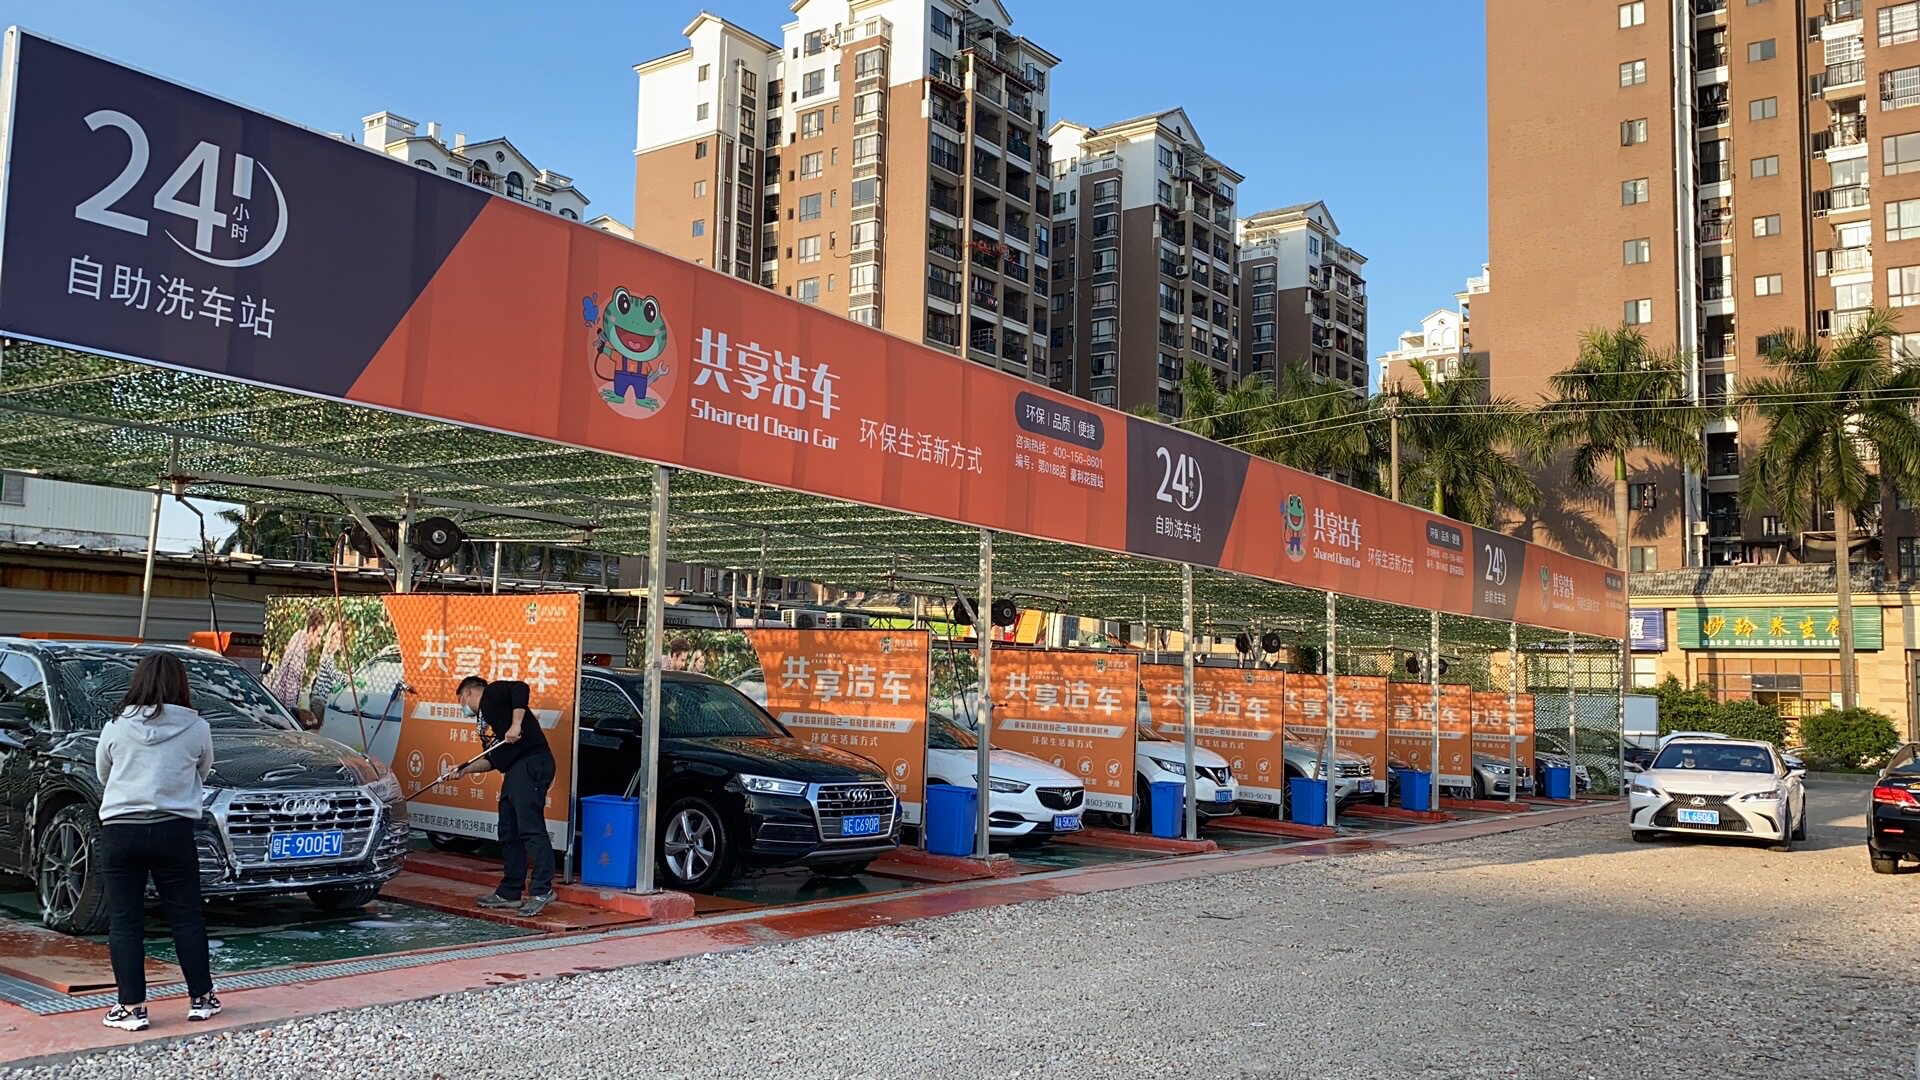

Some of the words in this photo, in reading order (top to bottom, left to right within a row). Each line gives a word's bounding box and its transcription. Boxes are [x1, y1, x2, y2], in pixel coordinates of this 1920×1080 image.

[75, 110, 227, 253] 24
[231, 203, 251, 243] 小时
[67, 254, 275, 339] 自助洗车站
[693, 327, 841, 420] 共享洁车
[690, 397, 759, 433] Shared
[763, 415, 809, 445] Clean
[813, 428, 840, 450] Car
[1025, 404, 1045, 425] 环保
[1052, 412, 1071, 433] 品质
[1077, 420, 1096, 440] 便捷
[859, 417, 983, 475] 环保生活新方式
[1156, 446, 1189, 506] 24
[1155, 514, 1202, 543] 自助洗车站
[1313, 507, 1362, 551] 共享洁车
[1367, 548, 1414, 575] 环保生活新方式
[1485, 544, 1501, 582] 24
[419, 627, 559, 693] 共享洁车
[781, 655, 912, 706] 共享洁车
[1004, 672, 1123, 717] 共享洁车
[1162, 683, 1271, 722] 共享洁车
[1388, 703, 1461, 725] 享洁车
[811, 731, 879, 747] 环保生活新方式
